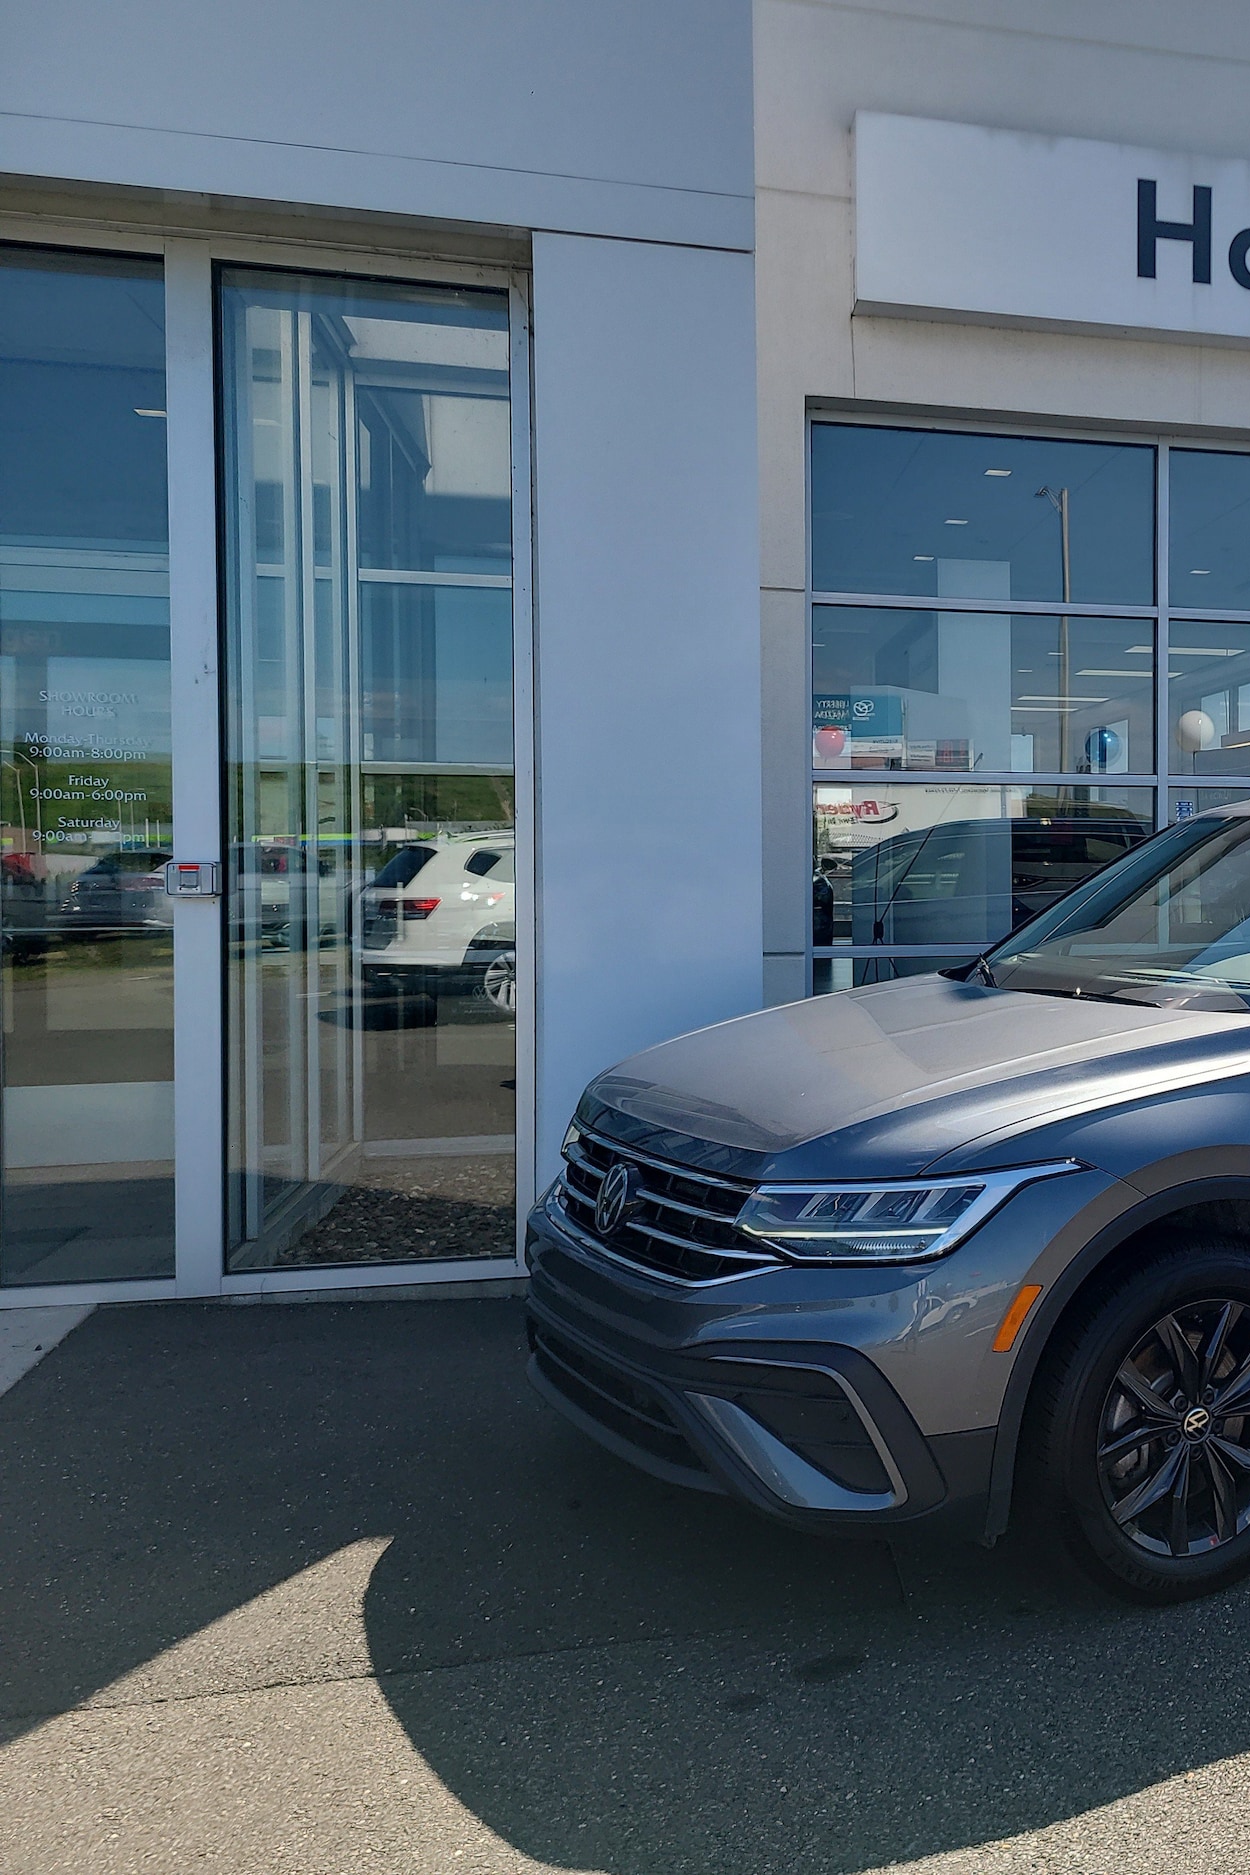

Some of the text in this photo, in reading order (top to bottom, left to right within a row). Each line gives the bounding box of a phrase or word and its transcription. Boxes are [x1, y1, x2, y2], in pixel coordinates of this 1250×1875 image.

[39, 690, 137, 704] SHOWROOM
[62, 705, 116, 718] HOURS
[24, 732, 150, 748] Monday-Thursday
[29, 746, 146, 762] 9:00am-8:00pm
[68, 775, 109, 789] Friday
[29, 788, 147, 803] 9:00am-6:00pm
[58, 816, 120, 830] Saturday
